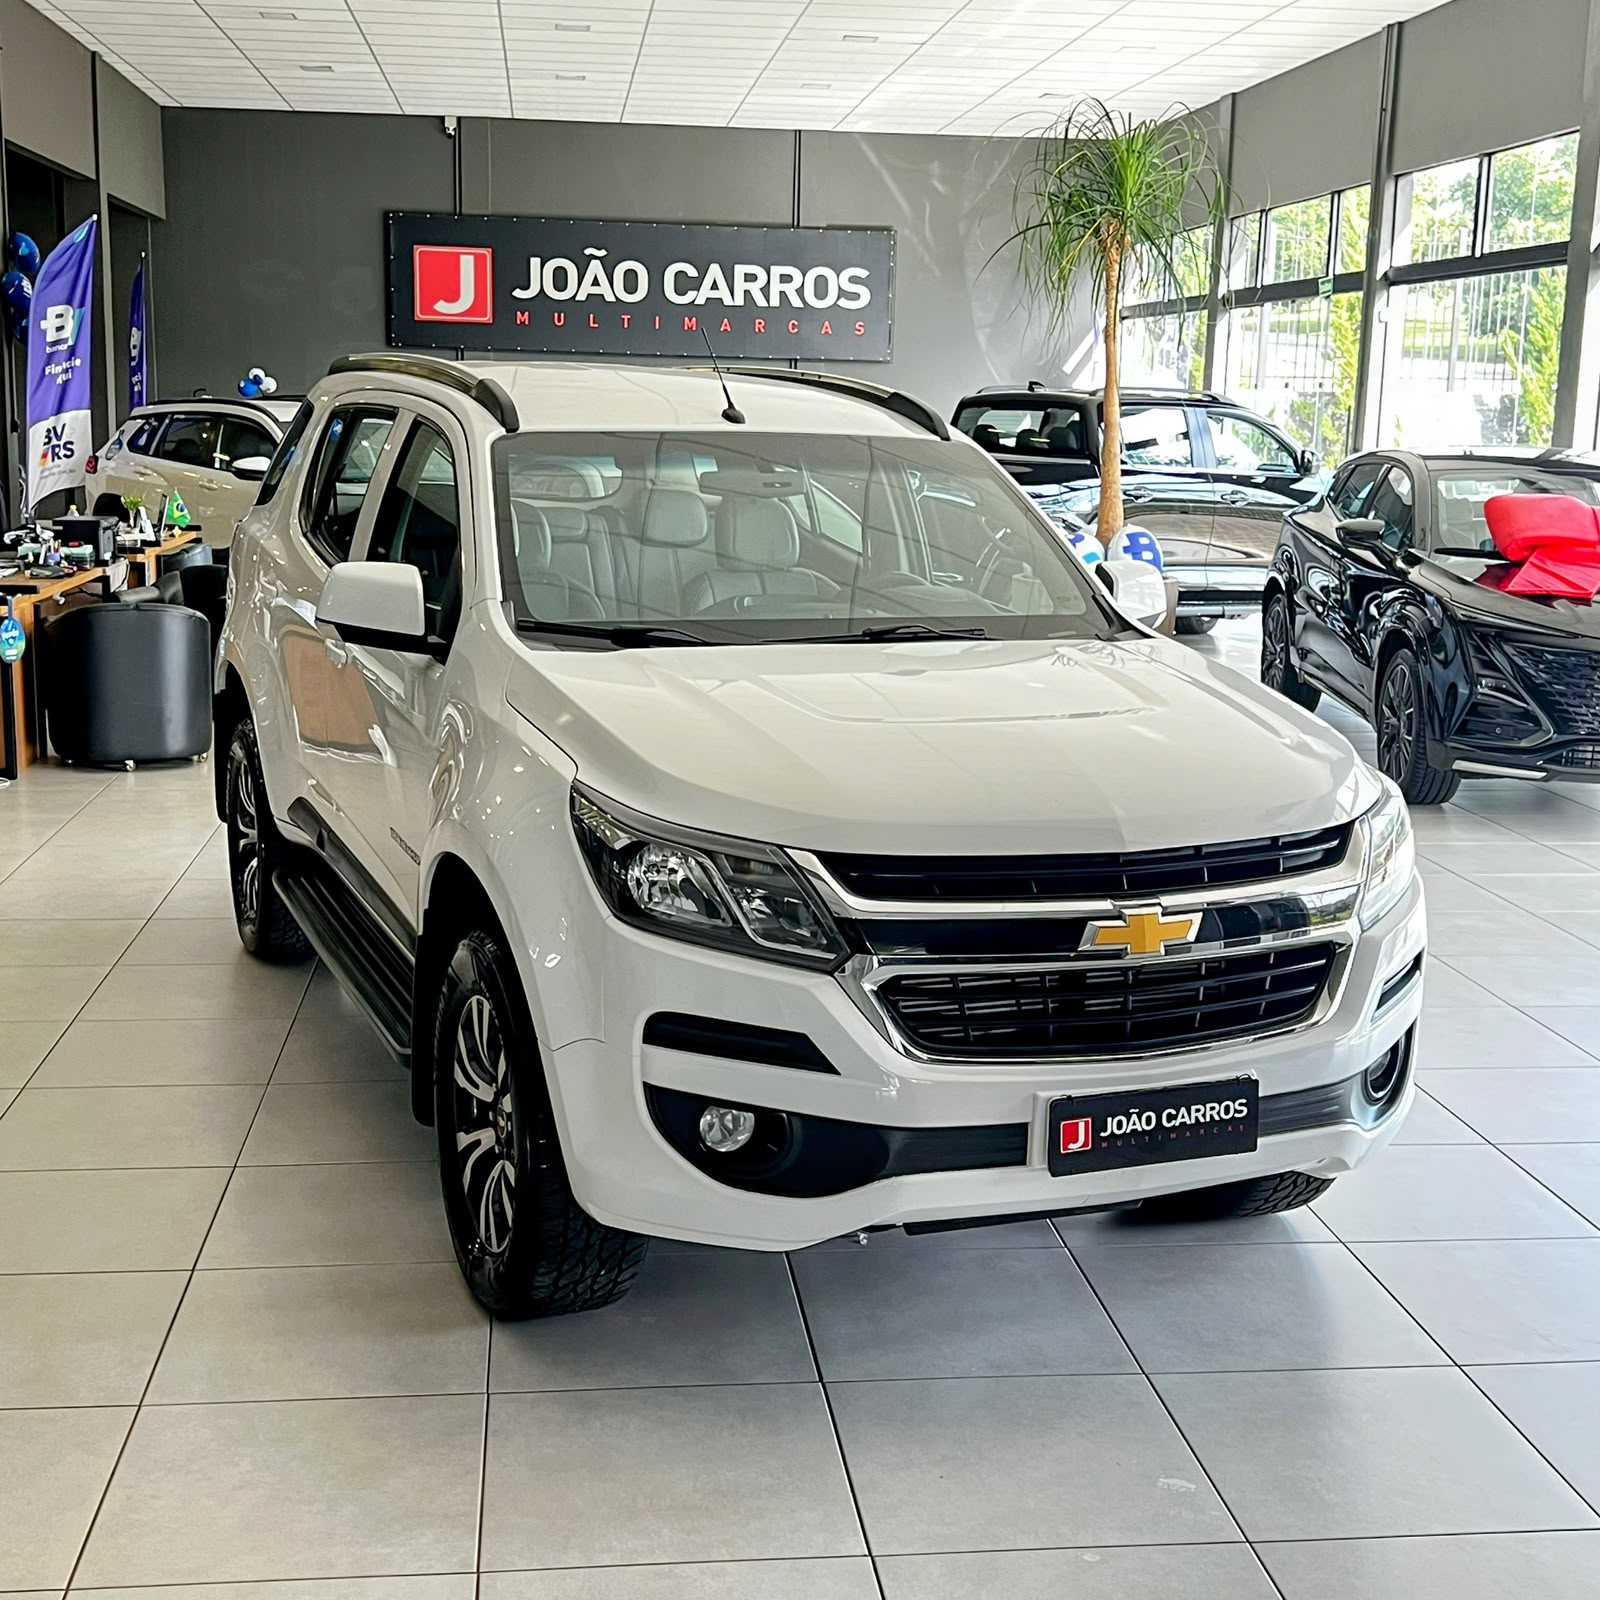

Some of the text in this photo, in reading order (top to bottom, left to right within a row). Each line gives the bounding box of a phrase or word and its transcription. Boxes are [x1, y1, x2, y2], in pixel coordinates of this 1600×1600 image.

[512, 247, 871, 310] JOÃO CARROS
[516, 311, 866, 336] MULTIMARCAS
[1100, 1099, 1248, 1137] JOÃO CARROS
